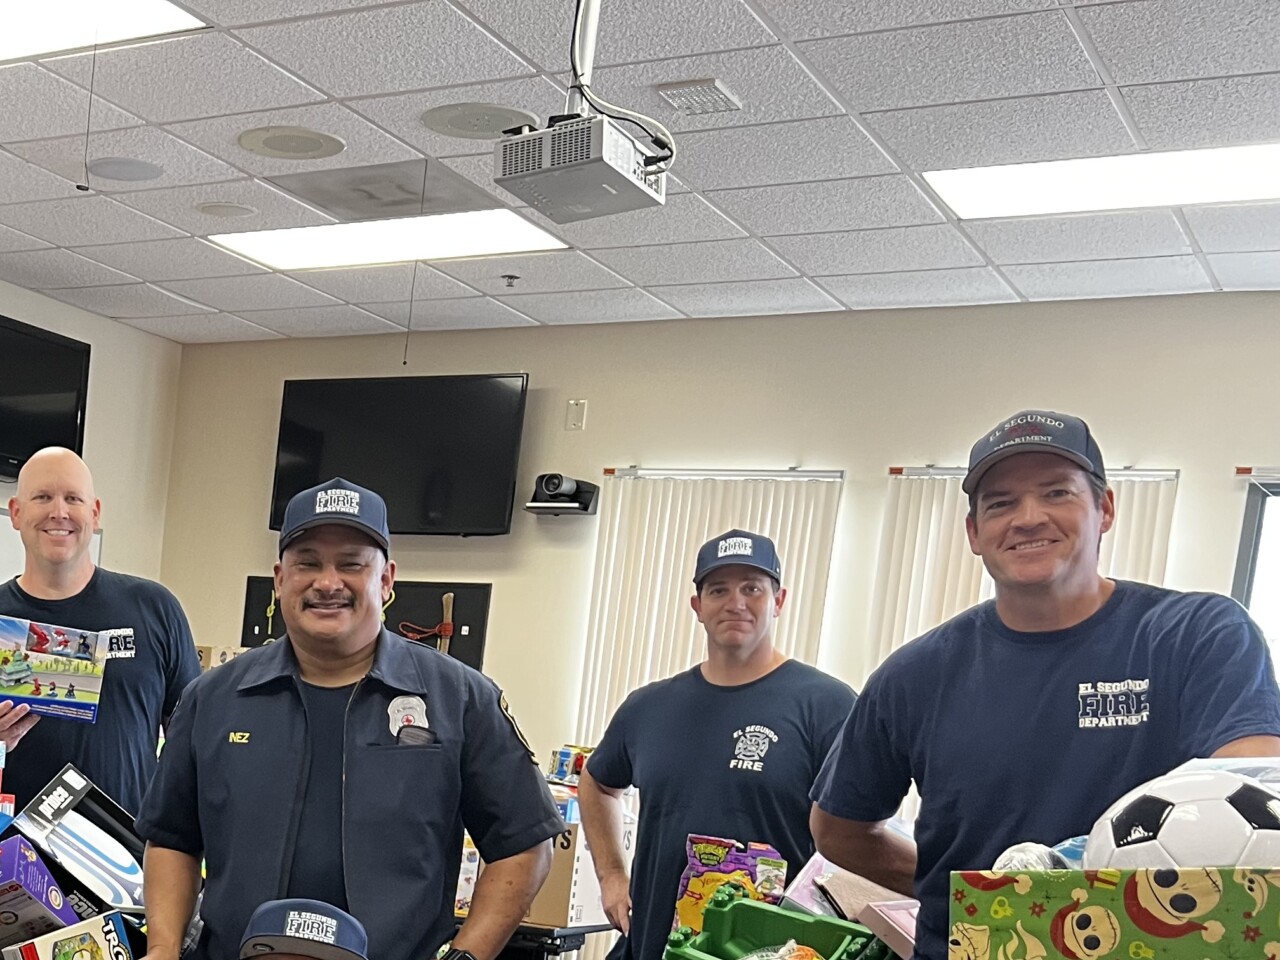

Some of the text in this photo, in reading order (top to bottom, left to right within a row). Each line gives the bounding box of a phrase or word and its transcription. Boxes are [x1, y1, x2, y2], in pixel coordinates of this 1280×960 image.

[1004, 414, 1064, 431] SEGUNDO
[316, 495, 360, 508] FIRE
[108, 635, 135, 652] RE
[1079, 679, 1150, 693] EL SEGUNDO
[1078, 690, 1150, 718] FIRE
[1079, 711, 1150, 728] DEPARTMET
[733, 725, 779, 743] EL SEGUNDO
[729, 759, 764, 771] FIRE
[38, 785, 70, 820] prince
[552, 829, 572, 850] YS
[301, 912, 337, 926] SEGUNDO
[286, 917, 336, 940] FIRE
